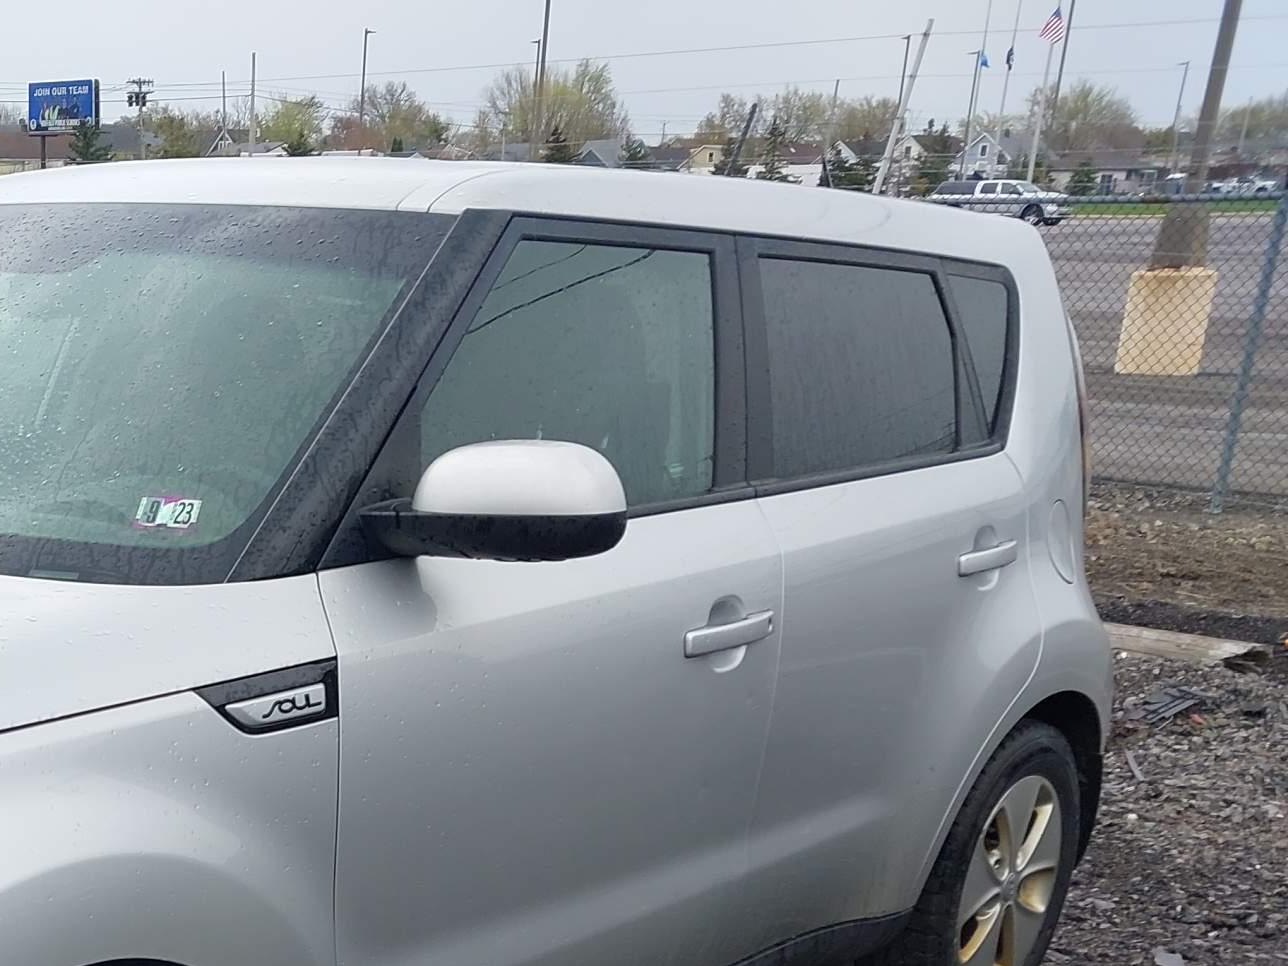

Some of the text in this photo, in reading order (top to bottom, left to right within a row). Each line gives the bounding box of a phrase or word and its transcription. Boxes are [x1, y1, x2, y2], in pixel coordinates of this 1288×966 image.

[33, 85, 89, 97] JOIN OUR TEAM
[146, 500, 194, 525] 9 23
